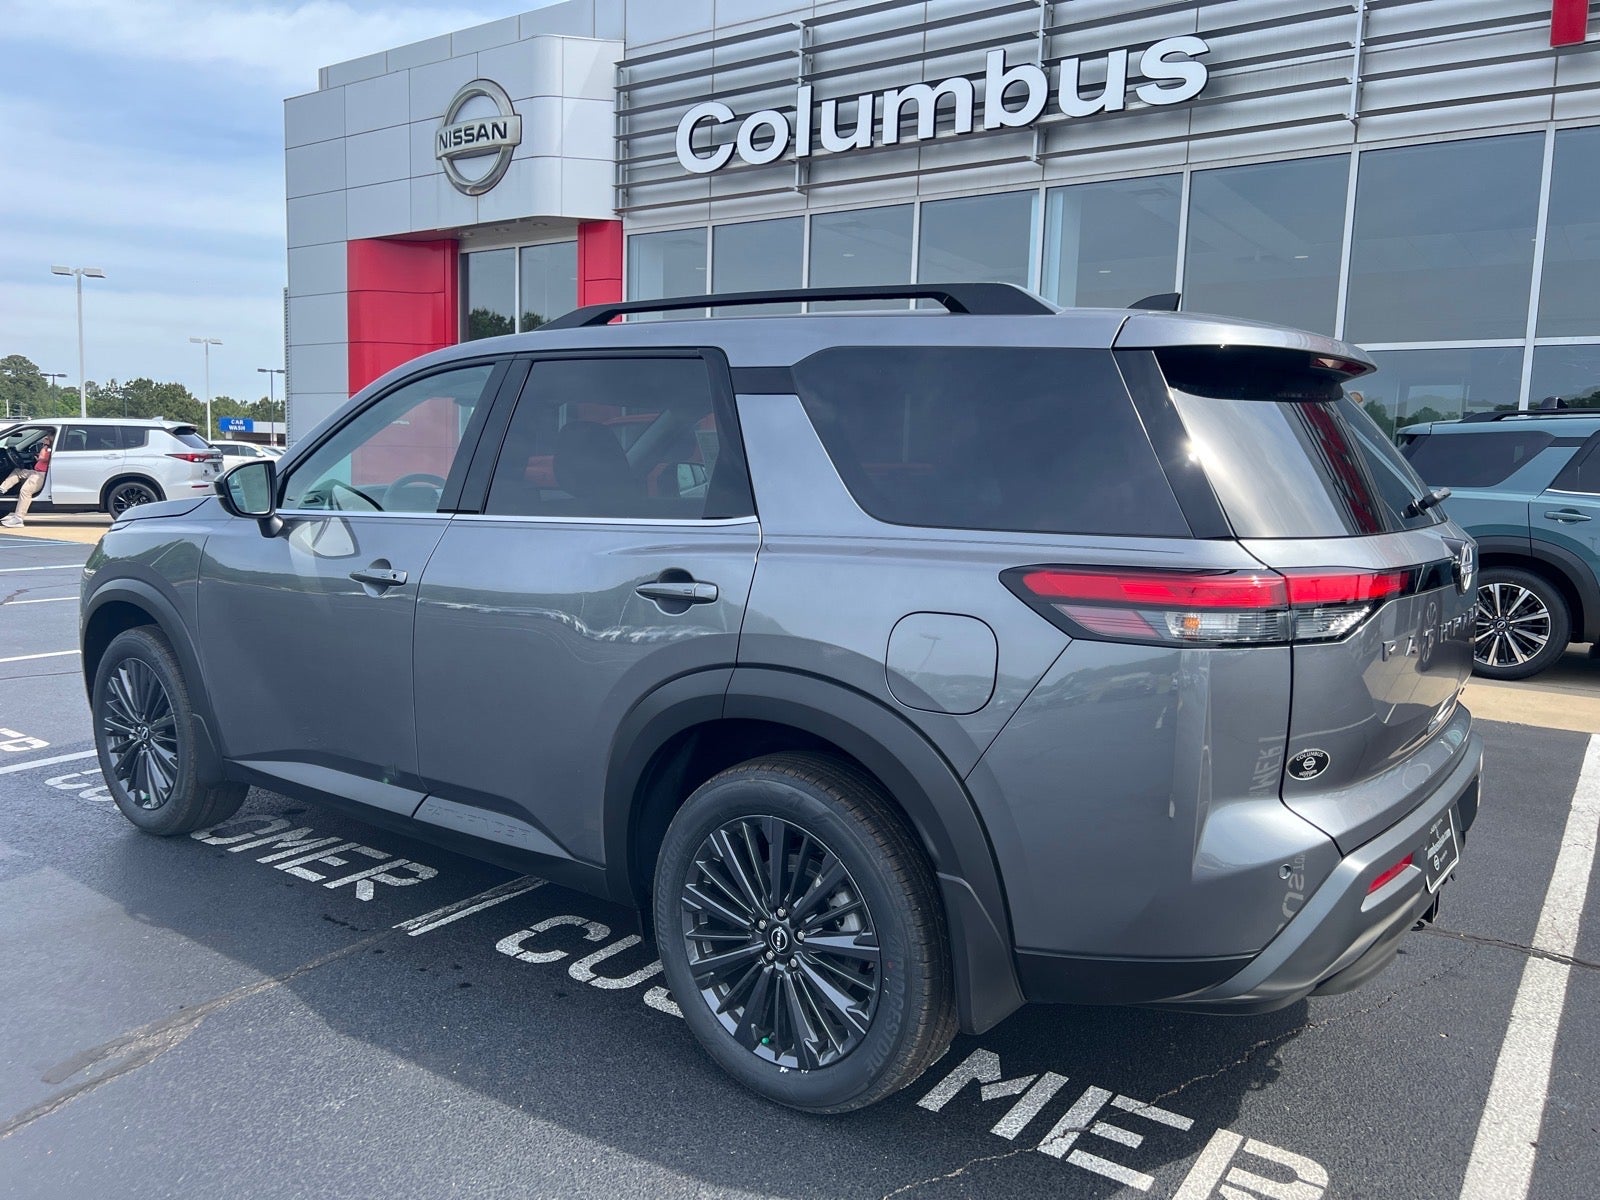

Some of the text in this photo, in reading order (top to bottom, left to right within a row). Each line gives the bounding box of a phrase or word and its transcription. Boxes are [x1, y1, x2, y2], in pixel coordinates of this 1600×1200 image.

[675, 34, 1211, 175] Columbus
[439, 122, 507, 151] NISSAN
[1382, 602, 1479, 663] PATHFIN
[1296, 751, 1324, 762] COLUMBUS
[863, 934, 906, 1079] BRIDGESTONE
